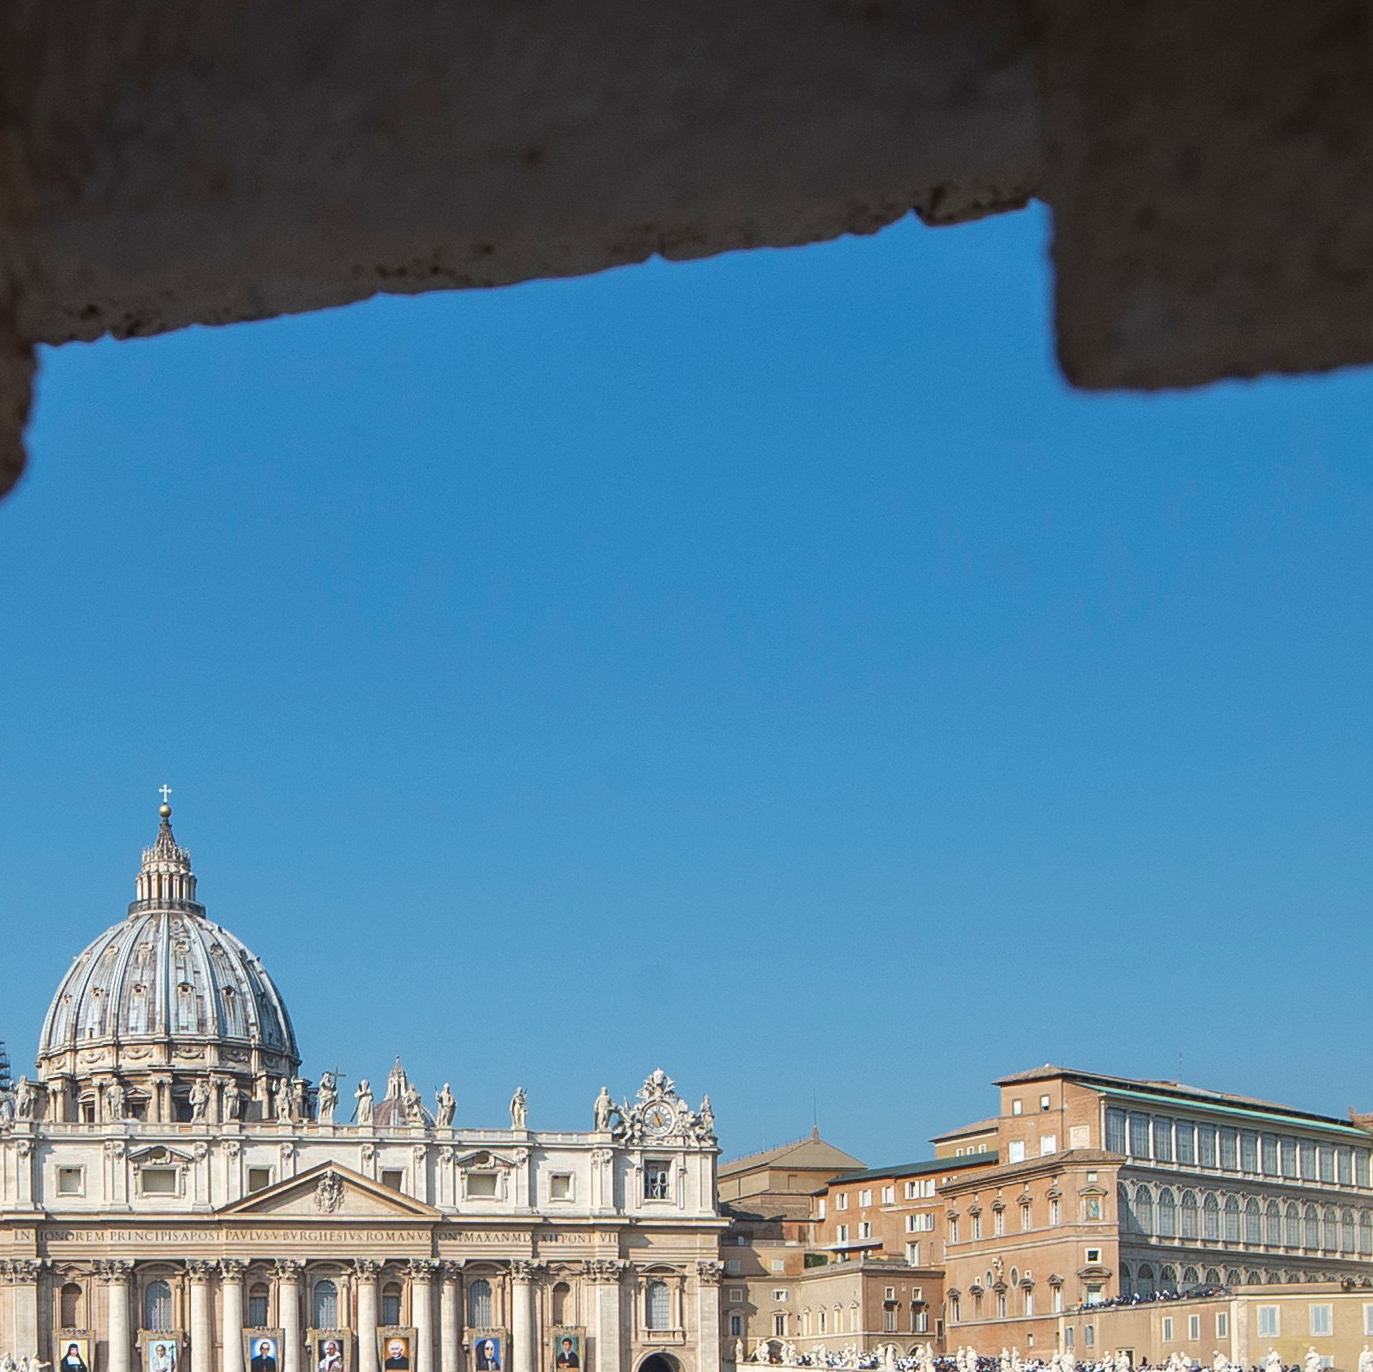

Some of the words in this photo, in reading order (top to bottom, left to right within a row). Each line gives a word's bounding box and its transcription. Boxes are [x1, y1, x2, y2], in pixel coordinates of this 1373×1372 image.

[14, 1230, 30, 1241] IN
[110, 1231, 179, 1241] PRINCIPIS
[225, 1231, 269, 1241] PAVLVS
[282, 1231, 365, 1241] BVRGHESIVS
[366, 1231, 431, 1241] ROMANVS
